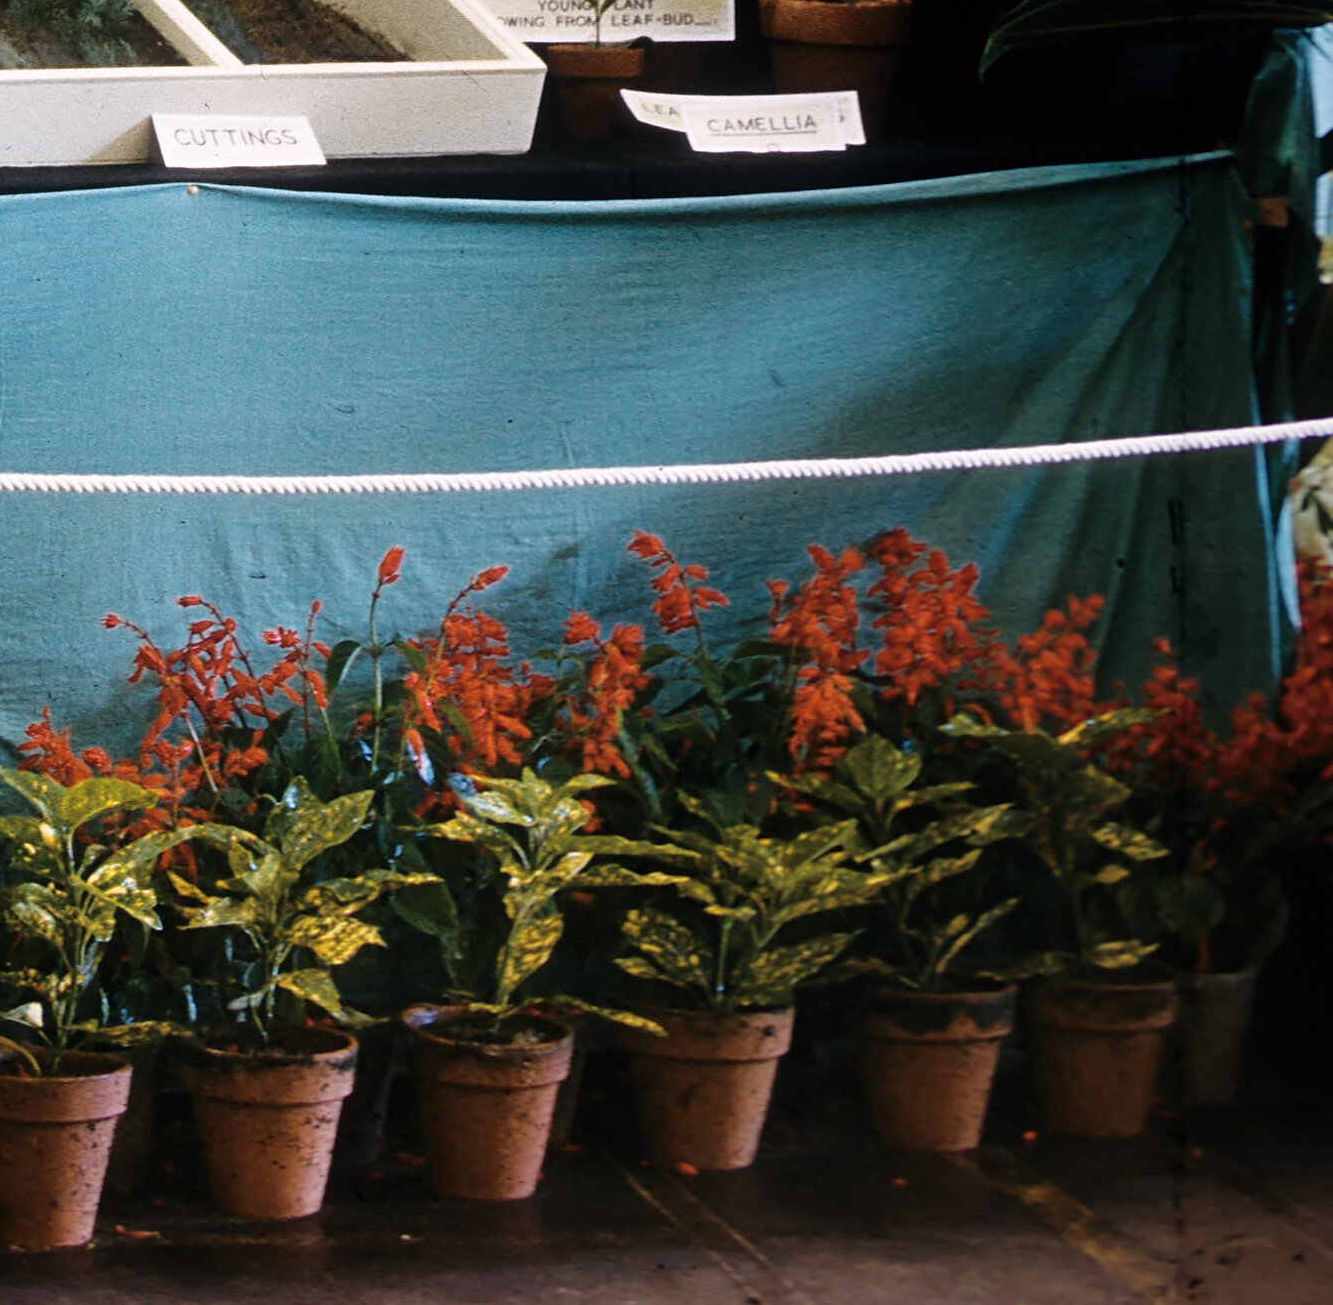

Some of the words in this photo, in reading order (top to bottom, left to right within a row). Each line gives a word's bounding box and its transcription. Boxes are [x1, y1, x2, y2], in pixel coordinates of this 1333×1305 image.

[556, 16, 598, 27] FROM
[611, 13, 694, 26] LEAF-BUD
[707, 114, 817, 131] CAMELLIA
[174, 128, 298, 146] CUTTINGS
